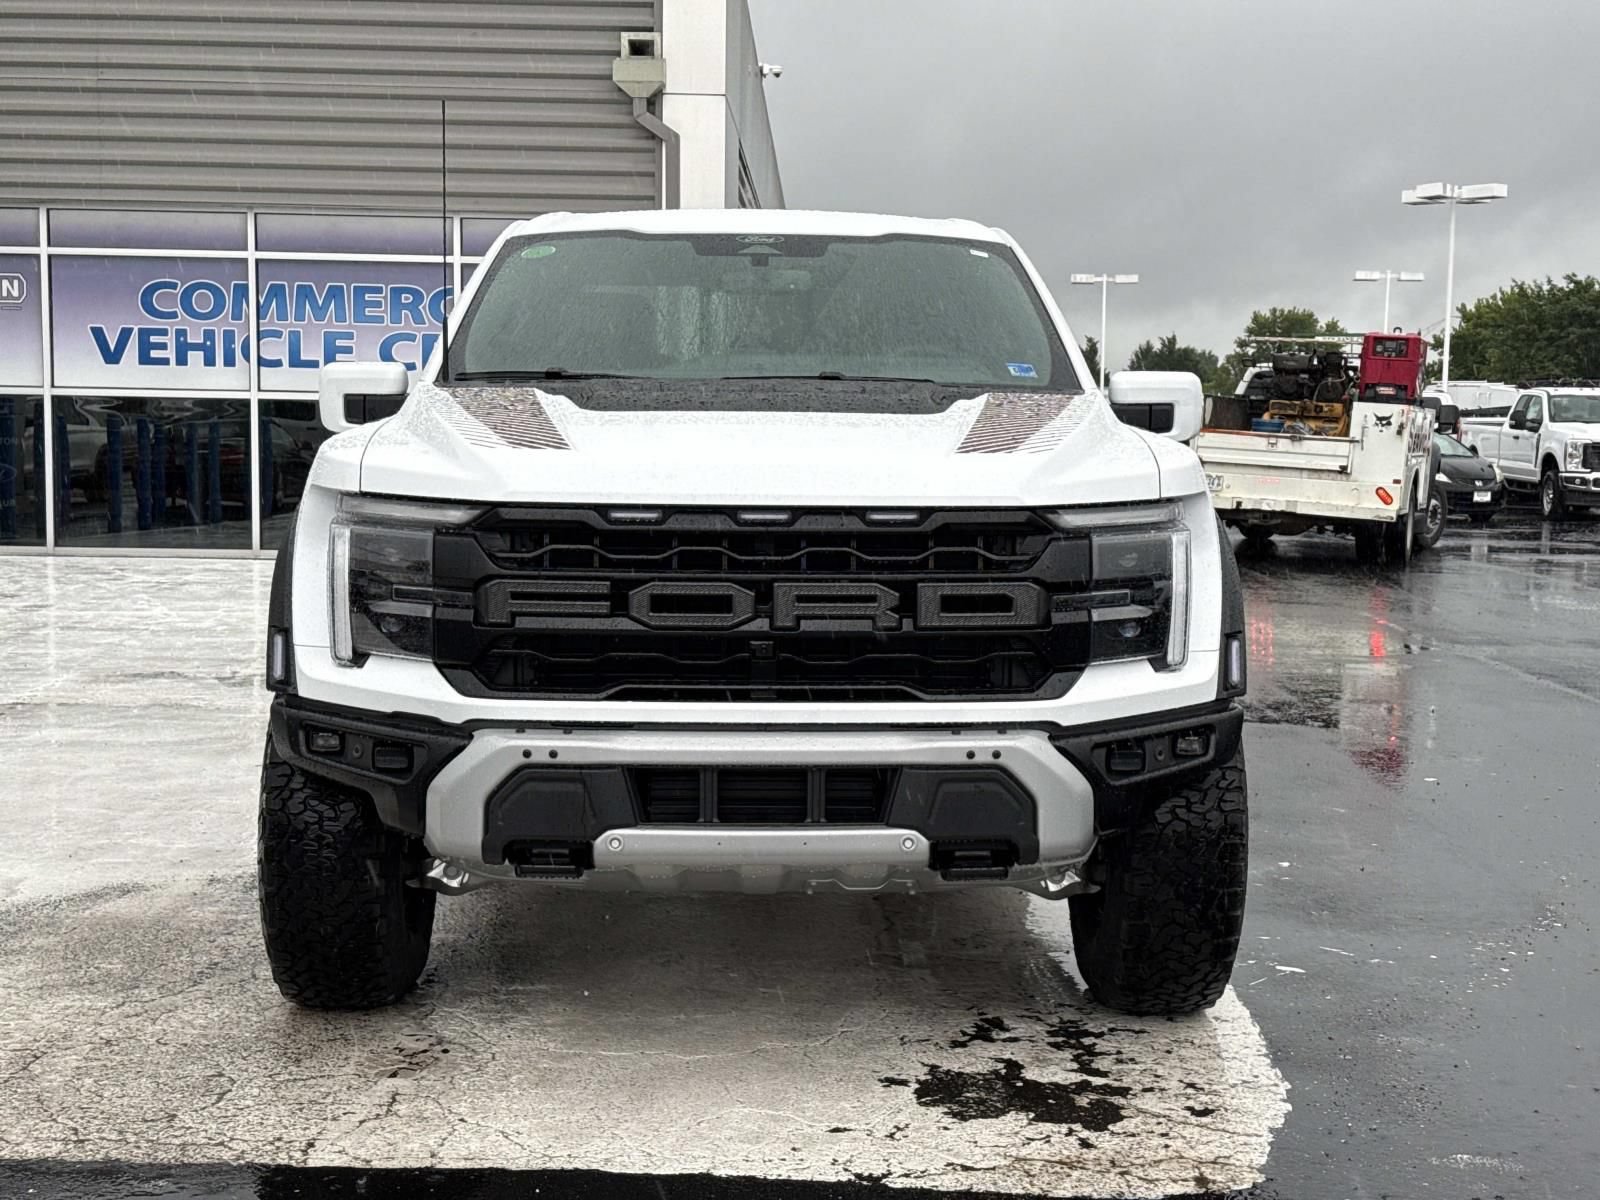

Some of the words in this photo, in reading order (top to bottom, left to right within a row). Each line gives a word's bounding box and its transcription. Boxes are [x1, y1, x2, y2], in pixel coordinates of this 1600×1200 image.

[138, 278, 454, 327] COMMERC
[88, 324, 356, 369] VEHICLE
[480, 578, 1044, 630] FORD
